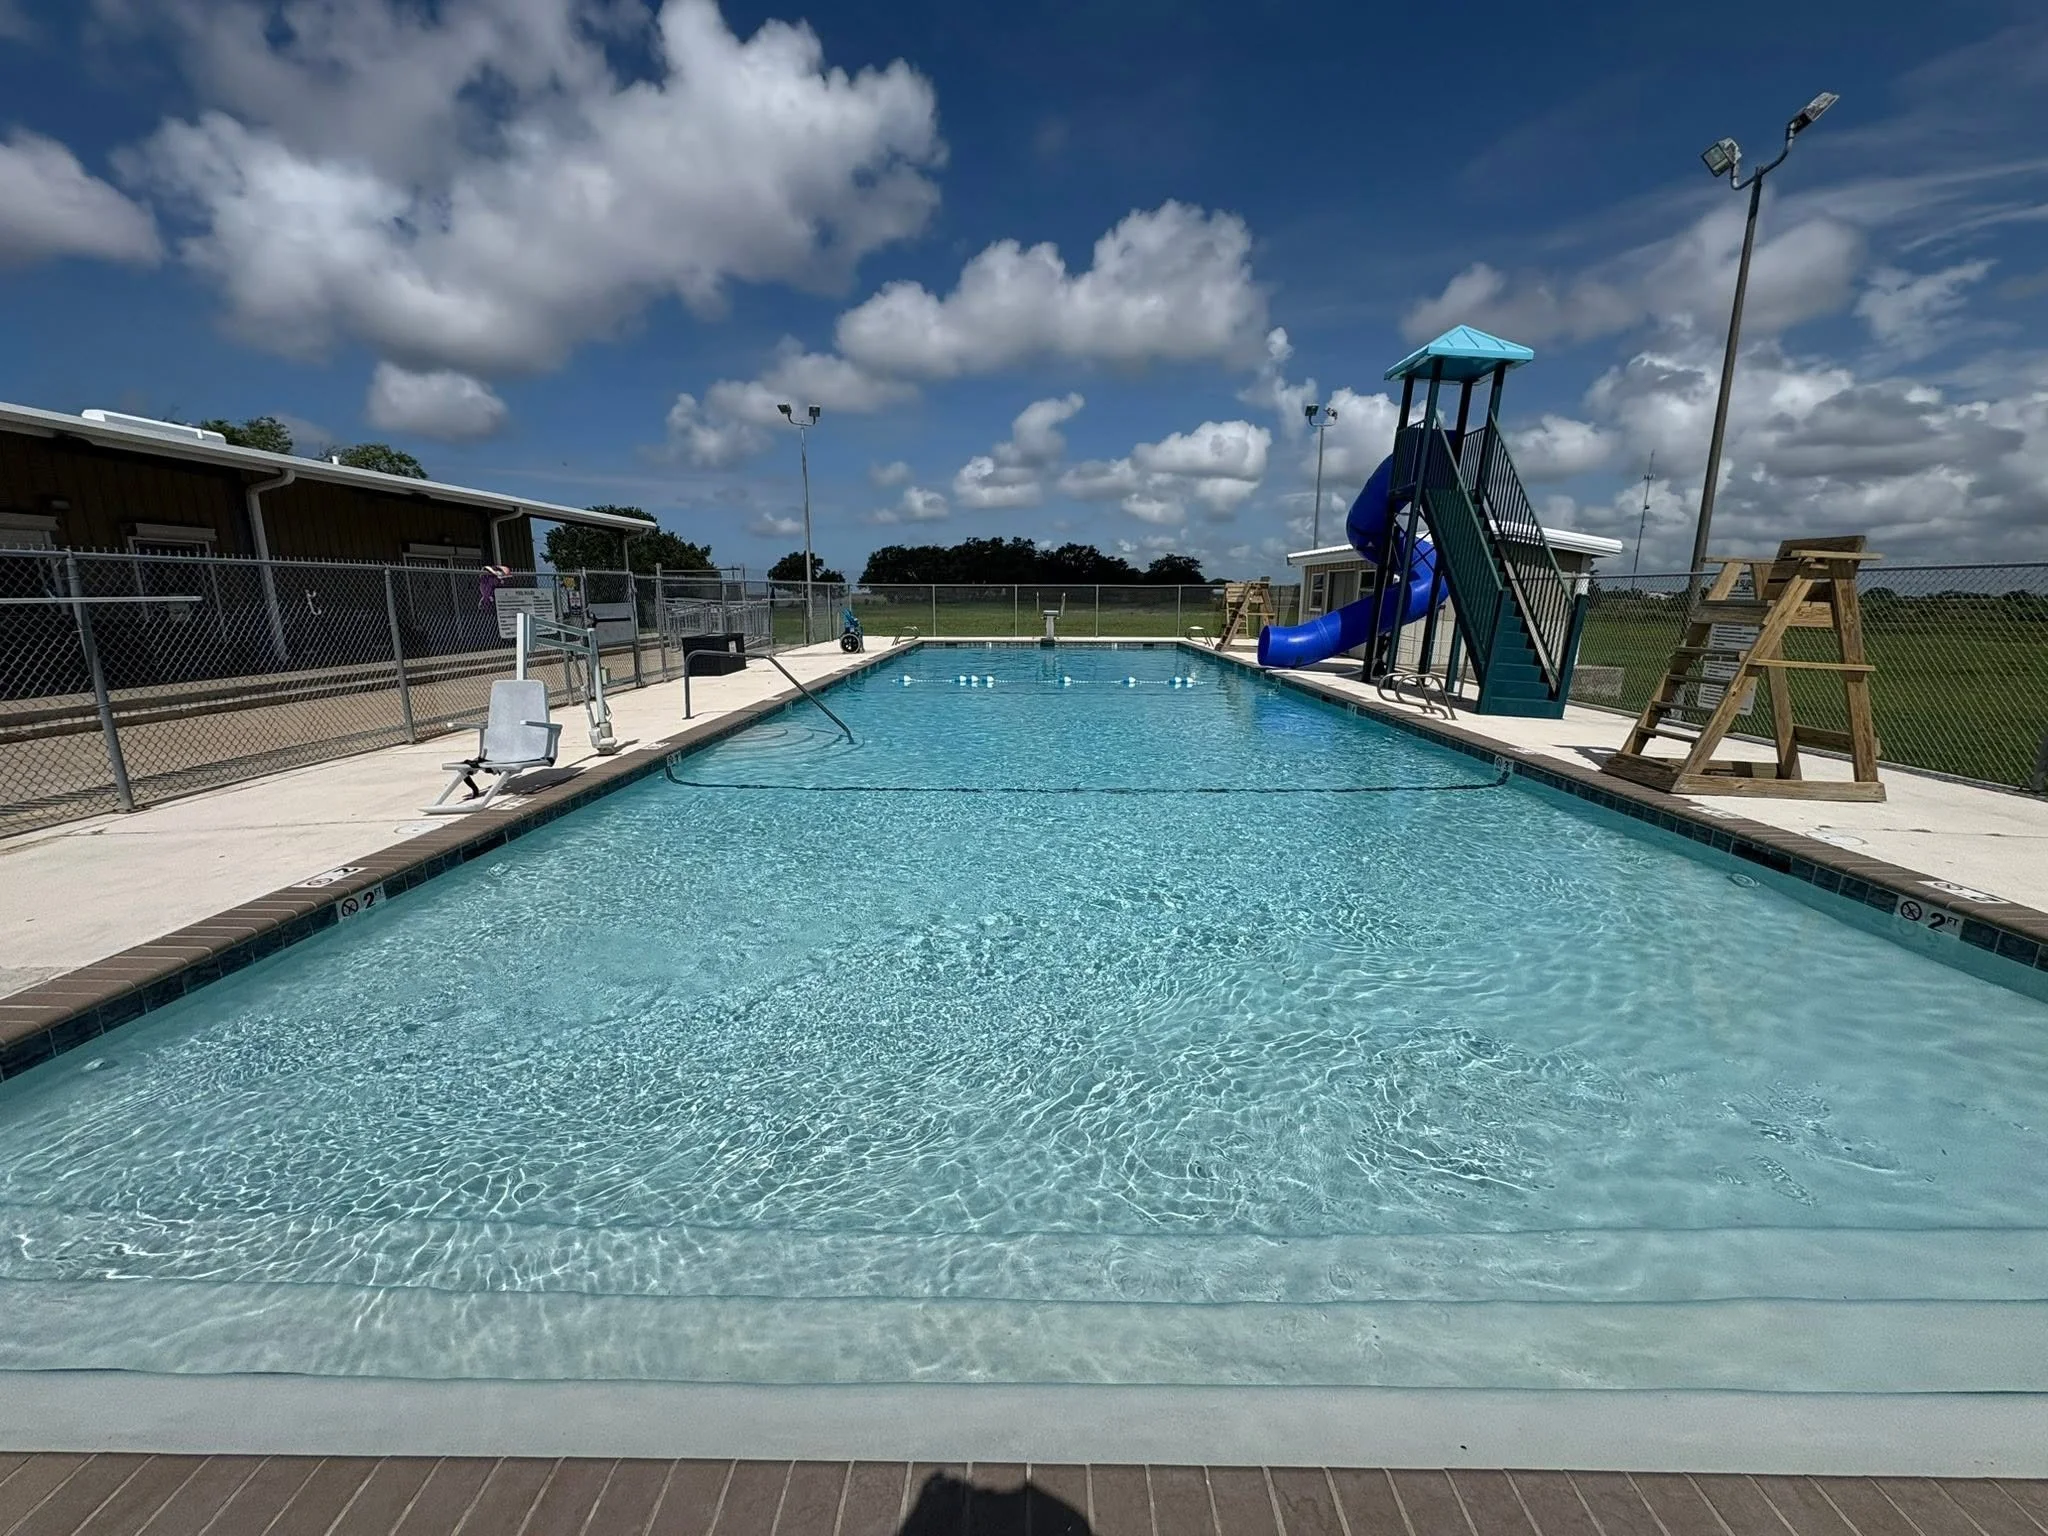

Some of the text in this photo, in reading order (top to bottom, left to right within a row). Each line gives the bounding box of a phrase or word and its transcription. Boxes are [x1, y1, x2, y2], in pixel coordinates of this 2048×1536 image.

[363, 891, 377, 909] 2
[1928, 912, 1960, 933] 2 FT
